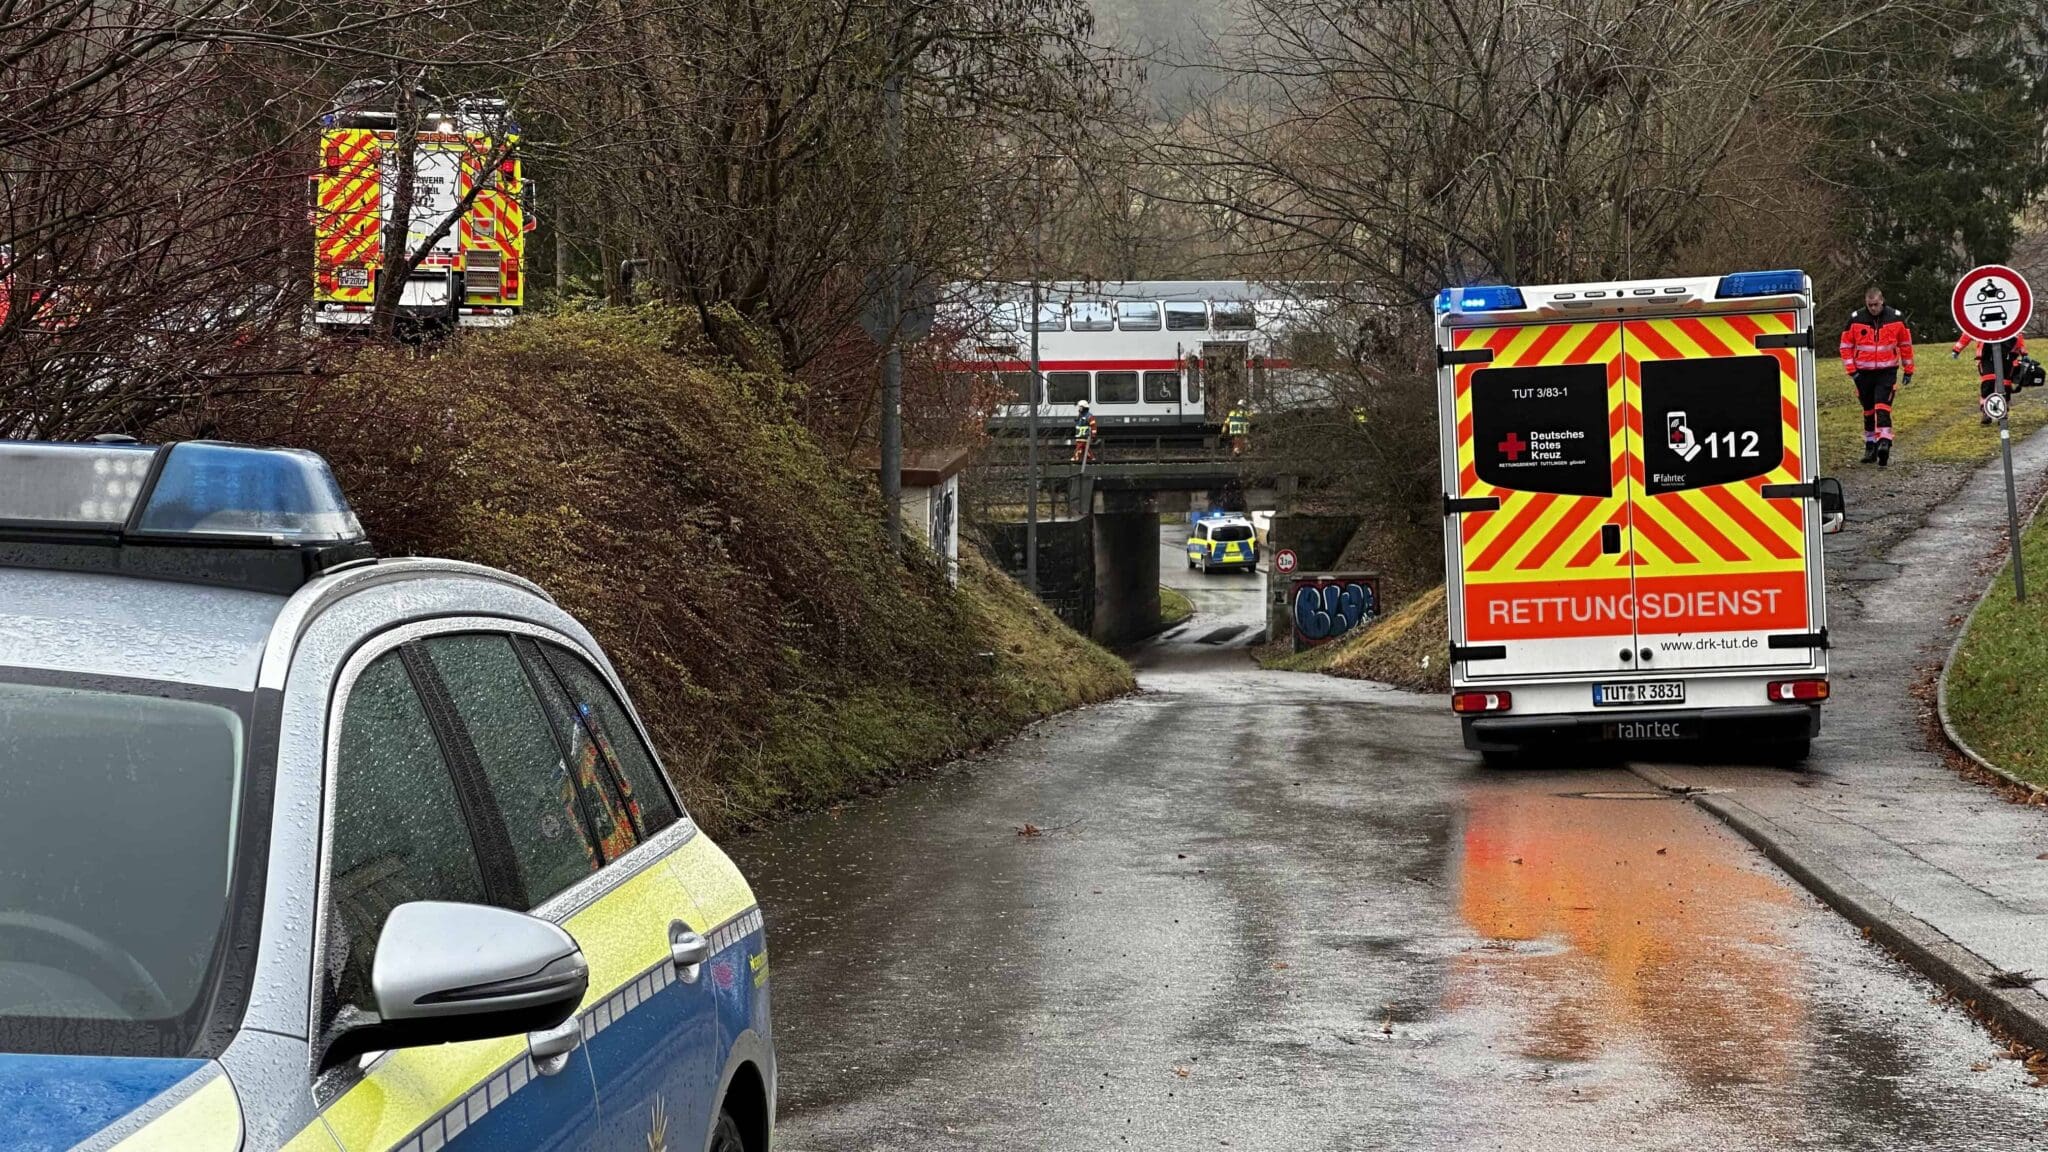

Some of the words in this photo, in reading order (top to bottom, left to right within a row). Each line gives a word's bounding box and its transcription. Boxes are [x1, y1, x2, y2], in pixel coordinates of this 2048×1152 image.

[1512, 388, 1534, 399] TUT
[1536, 387, 1568, 398] 3/83-1
[1530, 430, 1585, 441] Deutsches
[1531, 441, 1561, 450] Rotes
[1704, 430, 1760, 459] 112
[1531, 451, 1562, 460] Kreuz
[1660, 473, 1685, 483] fahrtec
[1488, 588, 1783, 625] RETTUNGSDIENST
[1660, 637, 1759, 651] www.drk-tut.de
[1602, 685, 1628, 701] TUT
[1638, 684, 1646, 699] R
[1650, 683, 1682, 699] 3831
